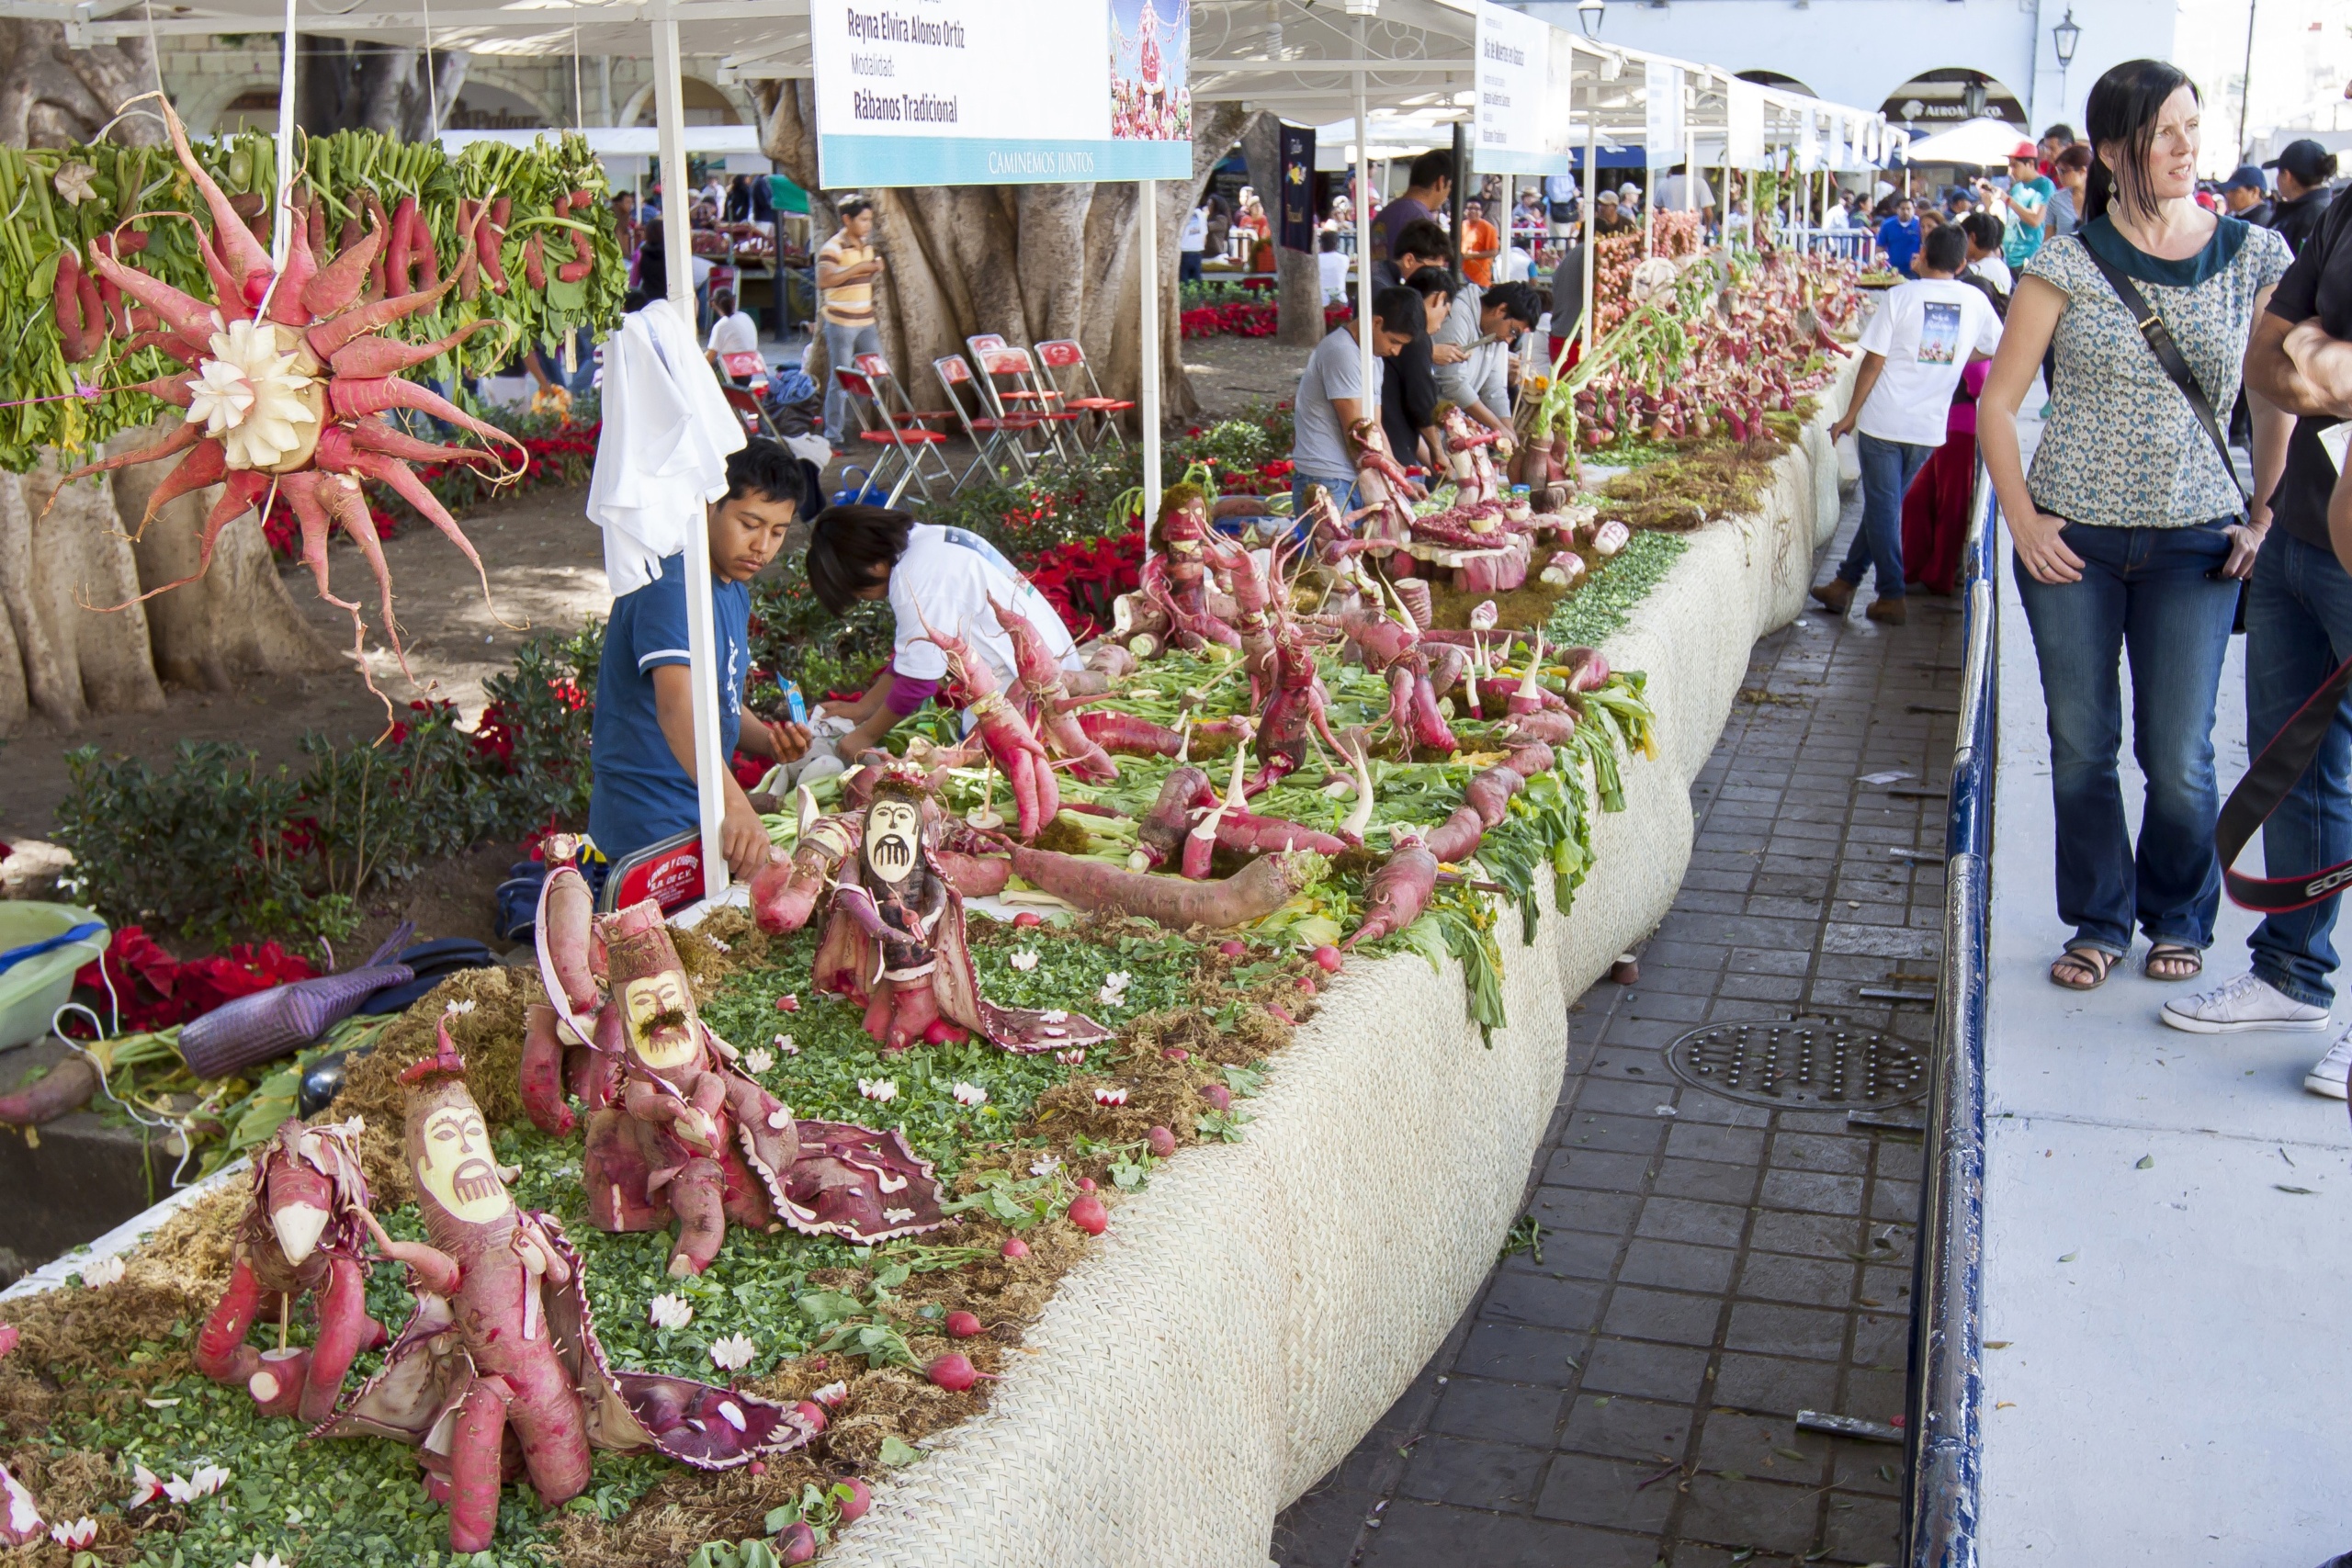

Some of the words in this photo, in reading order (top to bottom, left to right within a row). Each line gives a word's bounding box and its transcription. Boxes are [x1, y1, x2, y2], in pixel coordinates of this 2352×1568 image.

[847, 7, 879, 45] Reyna
[881, 10, 910, 43] Elvira
[911, 14, 942, 47] Alonso
[943, 19, 966, 49] Ortiz
[851, 52, 895, 77] Modalidad:
[854, 87, 900, 121] Rábanos
[902, 93, 958, 123] Tradicional
[988, 151, 1055, 175] CAMINEMOS
[1057, 152, 1094, 177] JUNTOS
